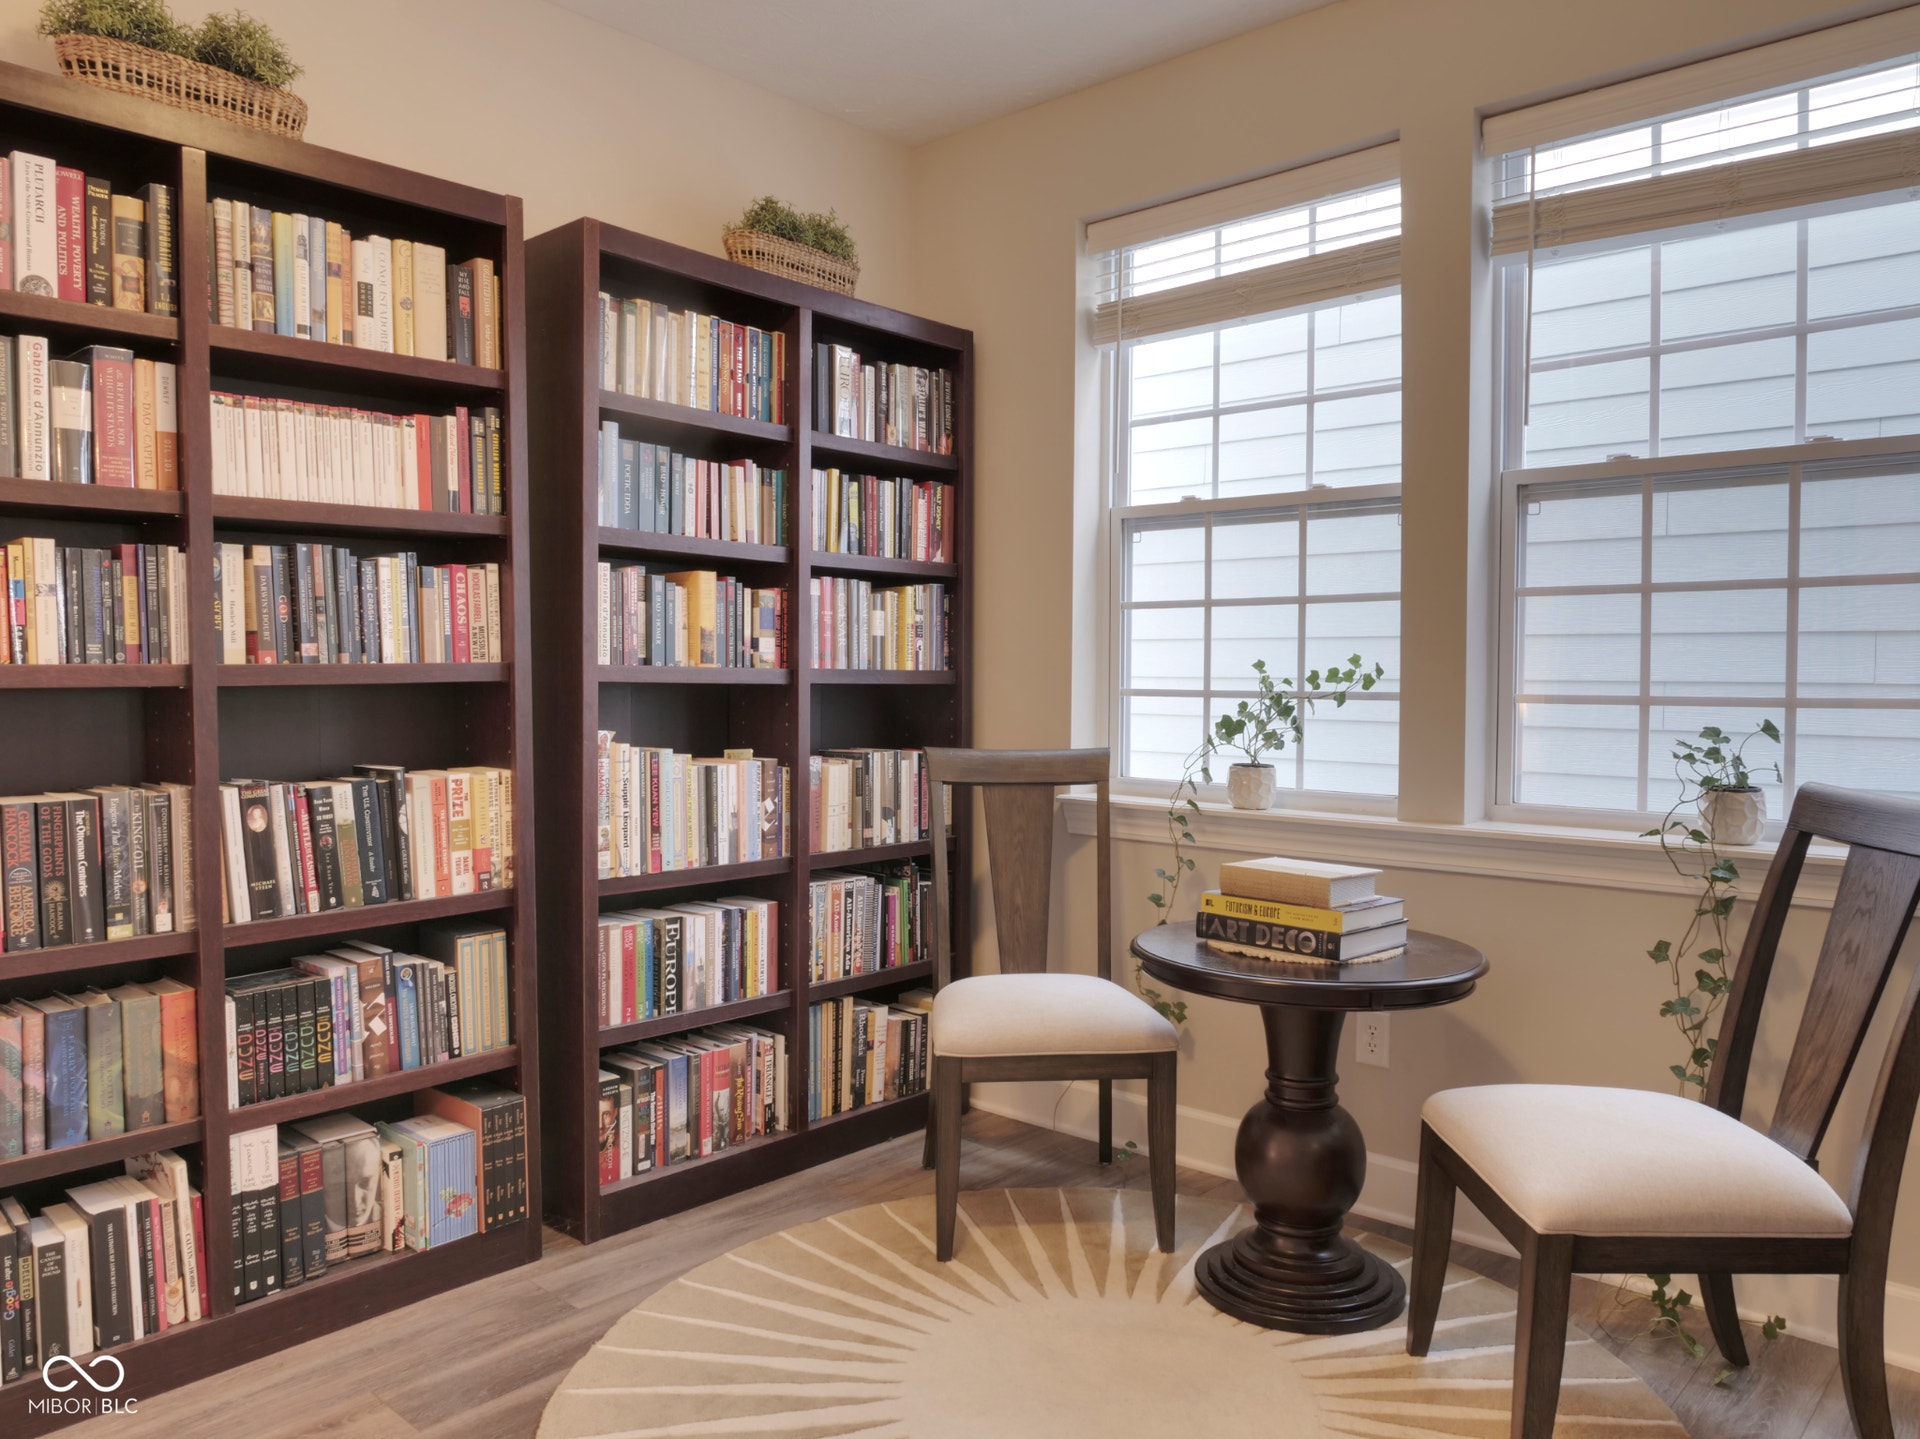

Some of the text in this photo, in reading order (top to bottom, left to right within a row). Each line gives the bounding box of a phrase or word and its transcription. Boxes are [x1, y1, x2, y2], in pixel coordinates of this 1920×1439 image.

[34, 163, 45, 224] PLUTARCH
[57, 204, 68, 276] AND POLITICS
[71, 196, 83, 291] WEALTH, POVERTY
[158, 195, 172, 273] THE CORPORATION
[154, 302, 177, 311] ENGLISH
[32, 341, 44, 472] Gabriele d'Annunzio
[106, 367, 116, 448] WHICH STANDS
[116, 381, 125, 446] REPUBLIC FOR
[918, 385, 927, 438] STALIN'S WAR
[944, 381, 952, 431] DIVINE COMEDY
[142, 402, 153, 481] DAO CAPITAL
[492, 463, 500, 494] WARRIORS
[624, 464, 632, 514] POETIC EDDA
[658, 465, 667, 516] ILIAD HOMER
[260, 574, 271, 641] DARWIN'S DOUBT
[279, 594, 289, 623] GOD
[365, 565, 375, 621] SNOW CRASH
[400, 573, 408, 601] MARBLE
[401, 602, 409, 619] MAN
[455, 571, 468, 625] CHAOS
[471, 572, 481, 624] NICHOLAS FARRELL
[214, 600, 222, 631] SECRET
[471, 631, 480, 661] NEW LIFE
[478, 625, 487, 661] MUSSOLINI
[451, 778, 464, 818] PRIZE
[651, 758, 661, 827] LEE KUAN YEW
[4, 806, 19, 869] HANCOCK
[18, 810, 31, 863] GRAHAM
[41, 806, 53, 878] OF THE GODS
[53, 805, 65, 877] FINGERPRINTS
[75, 810, 88, 898] The Ottoman Centuries
[110, 797, 122, 901] Engines That Move Markets
[132, 812, 144, 872] KING OIL
[301, 813, 317, 888] BATTLE CASBAH
[622, 810, 630, 848] Leopard
[462, 856, 470, 875] DANIEL
[832, 883, 841, 891] 70
[845, 882, 854, 890] 80
[8, 885, 23, 937] BEFORE
[21, 885, 35, 935] AMERICA
[49, 903, 57, 935] HANCOCK
[56, 902, 64, 931] GRAHAM
[833, 898, 841, 953] All-American
[856, 895, 864, 949] All-American
[1226, 900, 1252, 915] FUTURISM
[1254, 906, 1258, 916] &
[1260, 906, 1281, 920] EUROPE
[1207, 917, 1317, 954] ART DECO
[625, 1007, 632, 1017] 2
[858, 1013, 866, 1056] Rhodesia
[238, 1033, 254, 1081] DUNE
[255, 1029, 267, 1061] DUNE
[268, 1031, 284, 1074] DUNE
[285, 1031, 300, 1073] DUNE
[300, 1026, 316, 1070] DUNE
[317, 1021, 332, 1064] DUNE
[68, 1034, 78, 1114] HARRY POTTER
[765, 1056, 773, 1101] TRIANGLE
[734, 1076, 745, 1131] The Rising Sun
[4, 1255, 13, 1281] Life after
[21, 1257, 31, 1300] #DELETED
[147, 1250, 153, 1259] OF
[184, 1232, 197, 1294] CALVIN HOBBES
[110, 1287, 118, 1316] COLLECTION
